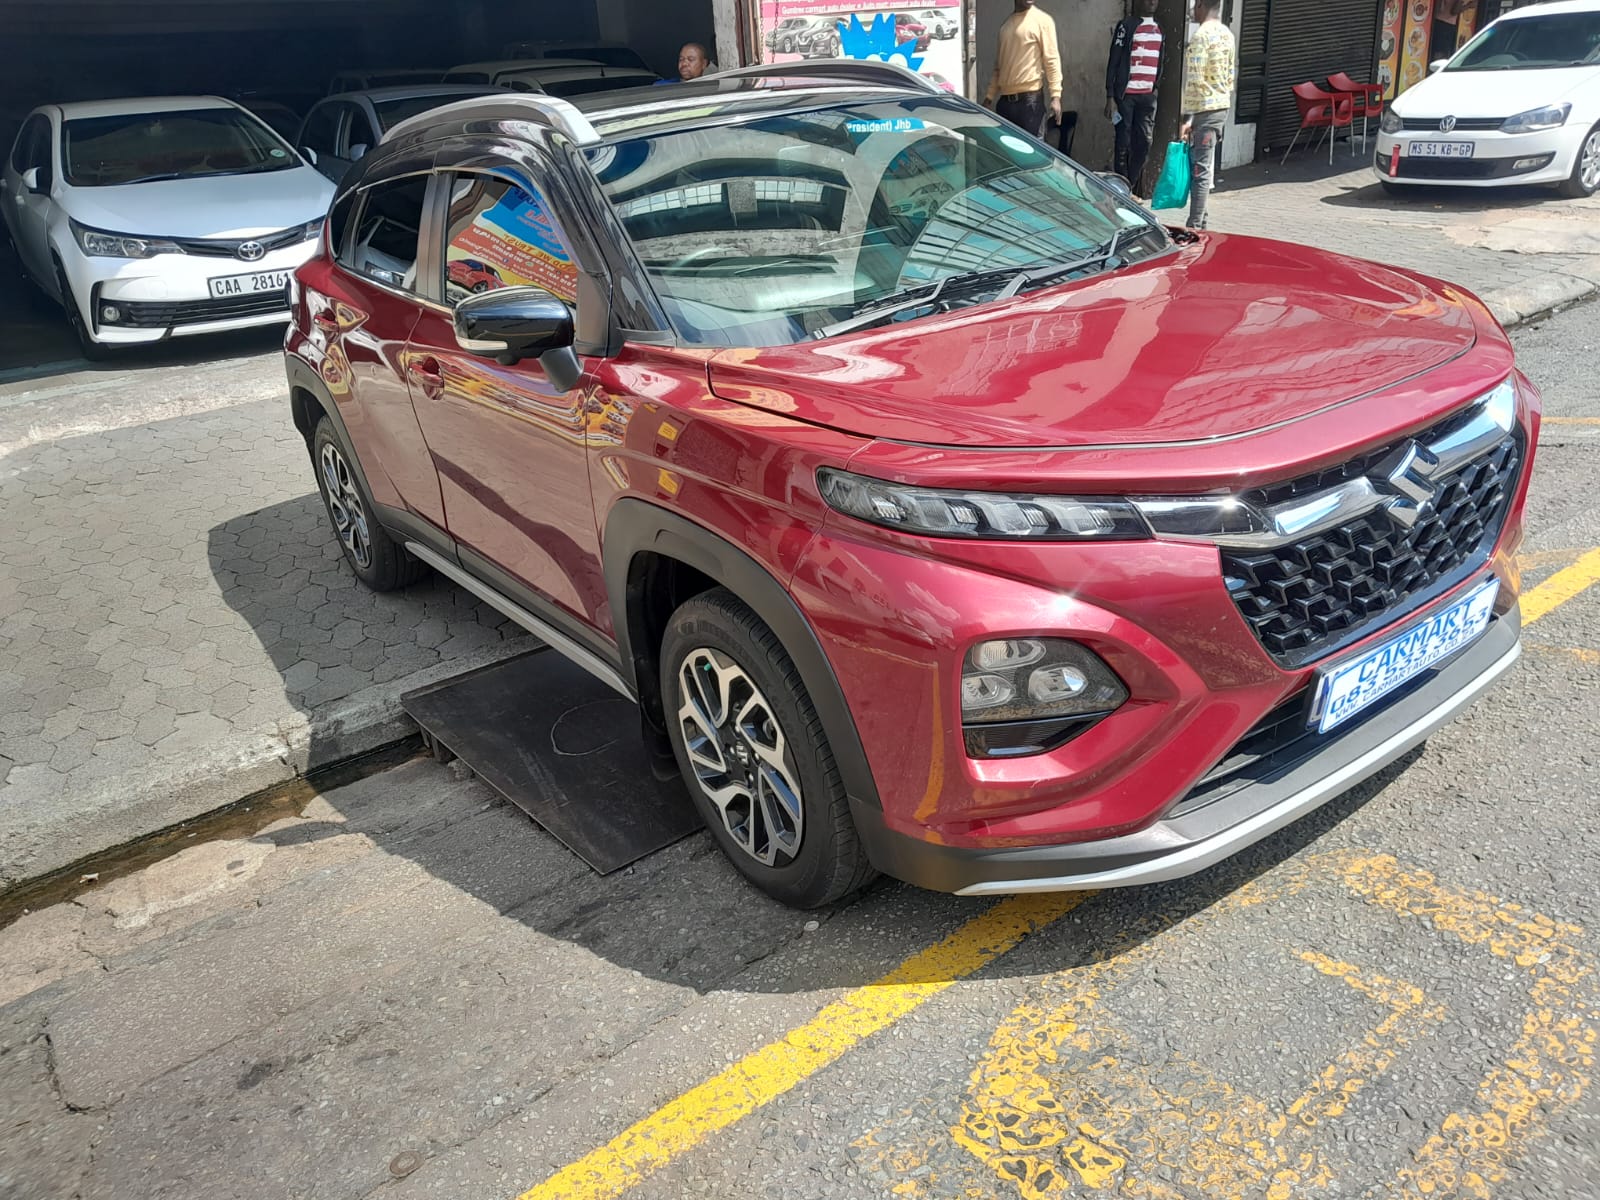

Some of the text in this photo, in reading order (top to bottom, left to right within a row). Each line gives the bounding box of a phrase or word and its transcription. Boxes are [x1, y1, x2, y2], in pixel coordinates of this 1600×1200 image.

[894, 119, 912, 130] Jhb
[1427, 143, 1437, 155] 51
[215, 278, 242, 296] CAA
[1358, 597, 1476, 683] CARMART
[1330, 606, 1489, 714] 083 533 3653
